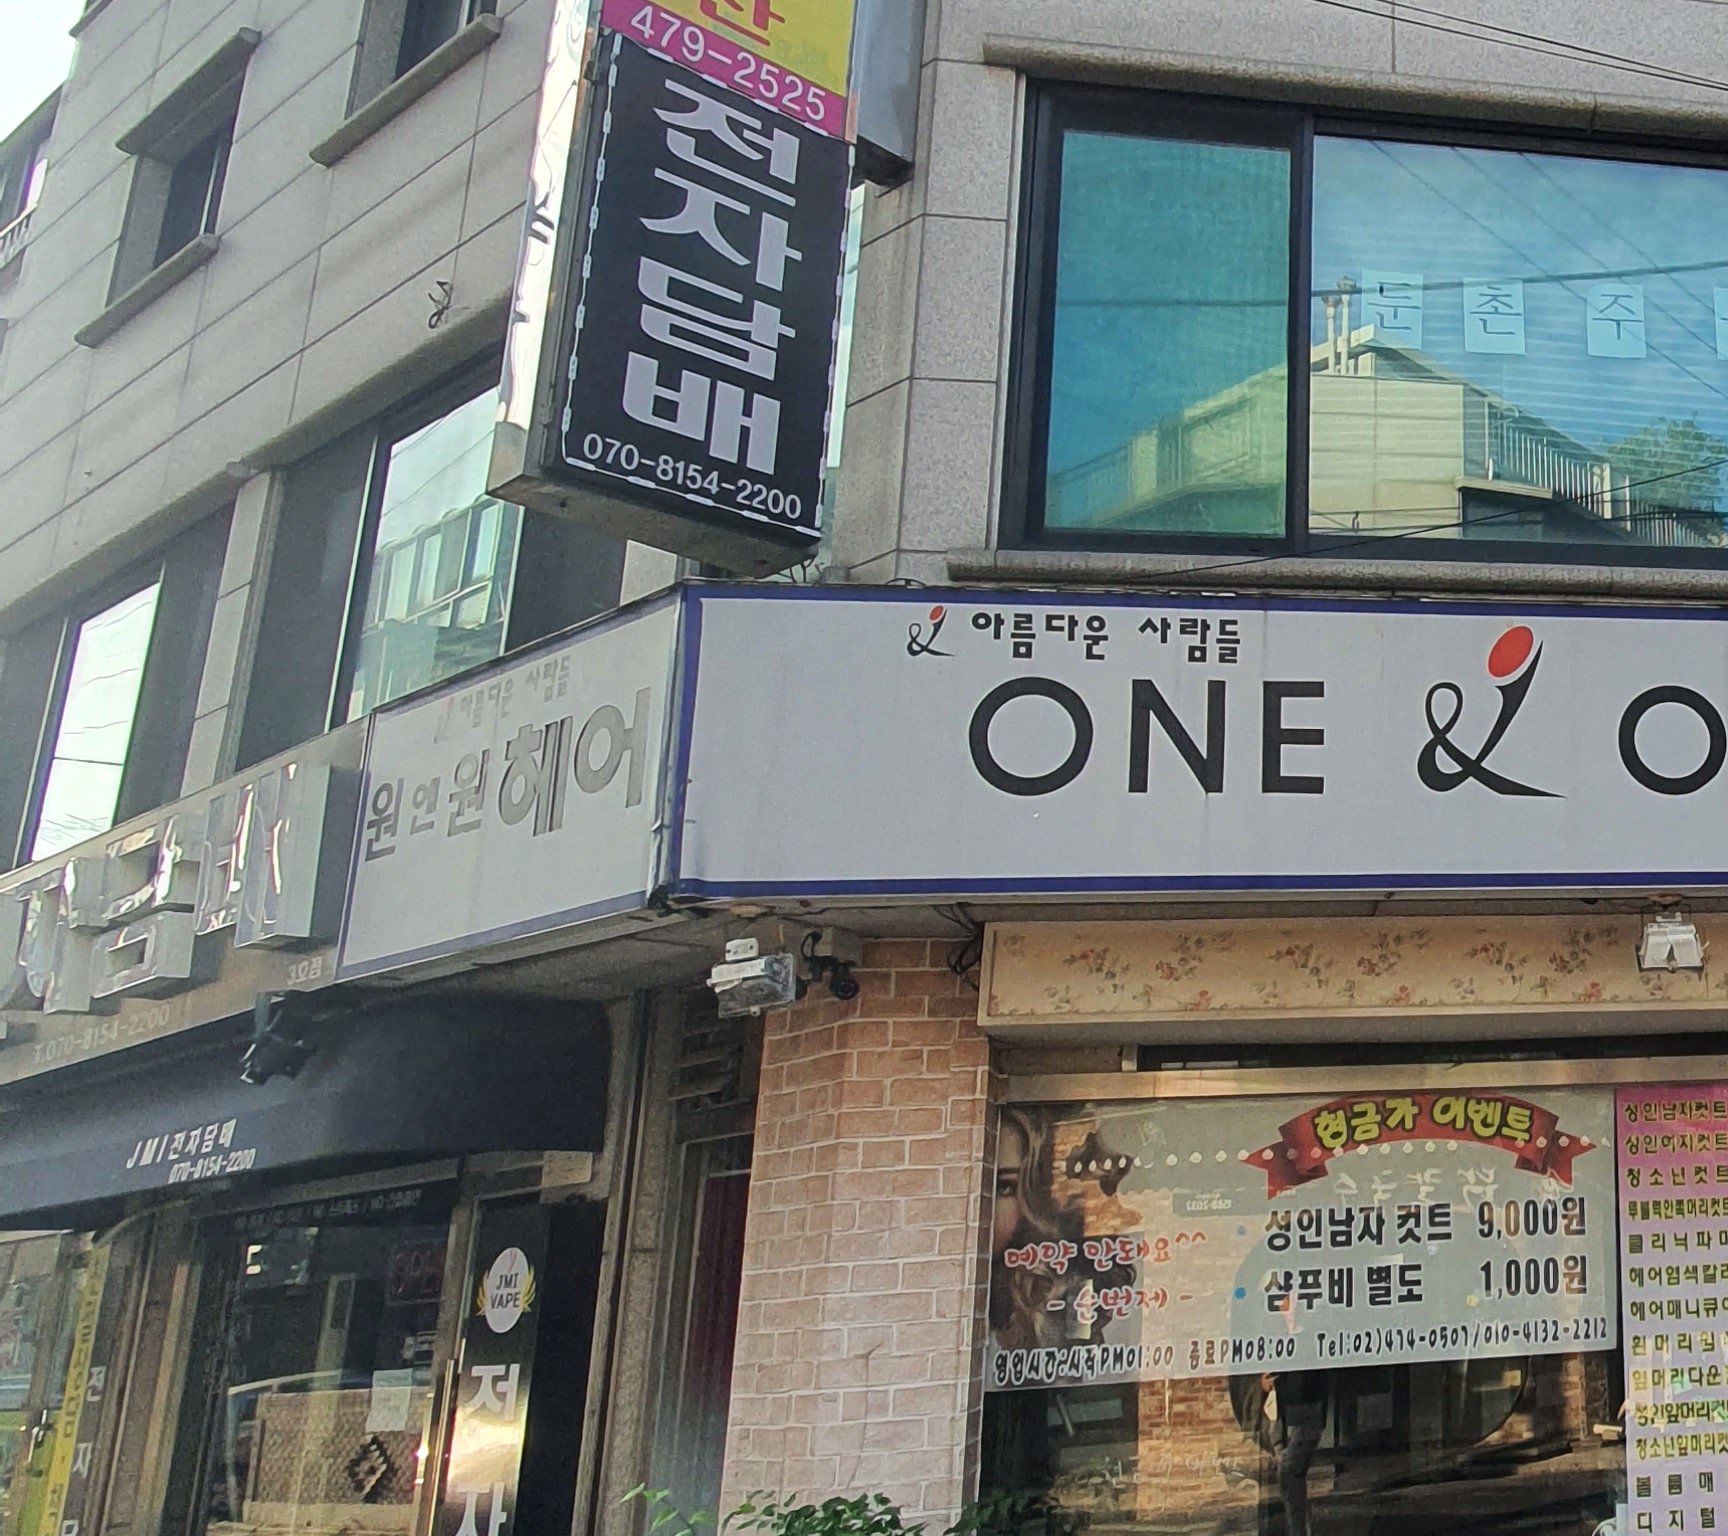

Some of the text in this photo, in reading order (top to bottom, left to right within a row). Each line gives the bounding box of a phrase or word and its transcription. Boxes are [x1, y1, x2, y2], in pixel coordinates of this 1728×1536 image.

[630, 5, 827, 122] 479-2525
[622, 77, 803, 475] 전자담배
[582, 432, 802, 520] 070-8154-2200
[971, 612, 1110, 660] 아름다운
[1138, 616, 1241, 664] 사람들
[968, 675, 1326, 797] ONE
[1313, 1096, 1532, 1149] 현금가 이벤트
[166, 1147, 257, 1184] 070-8154-2200
[1264, 1196, 1588, 1252] 성인남자 컷트 9,000원
[495, 1272, 519, 1291] JMI
[1004, 1240, 1078, 1275] 예약
[1263, 1254, 1588, 1312] 샴푸비 별도 1,000원
[490, 1291, 521, 1311] VAPE
